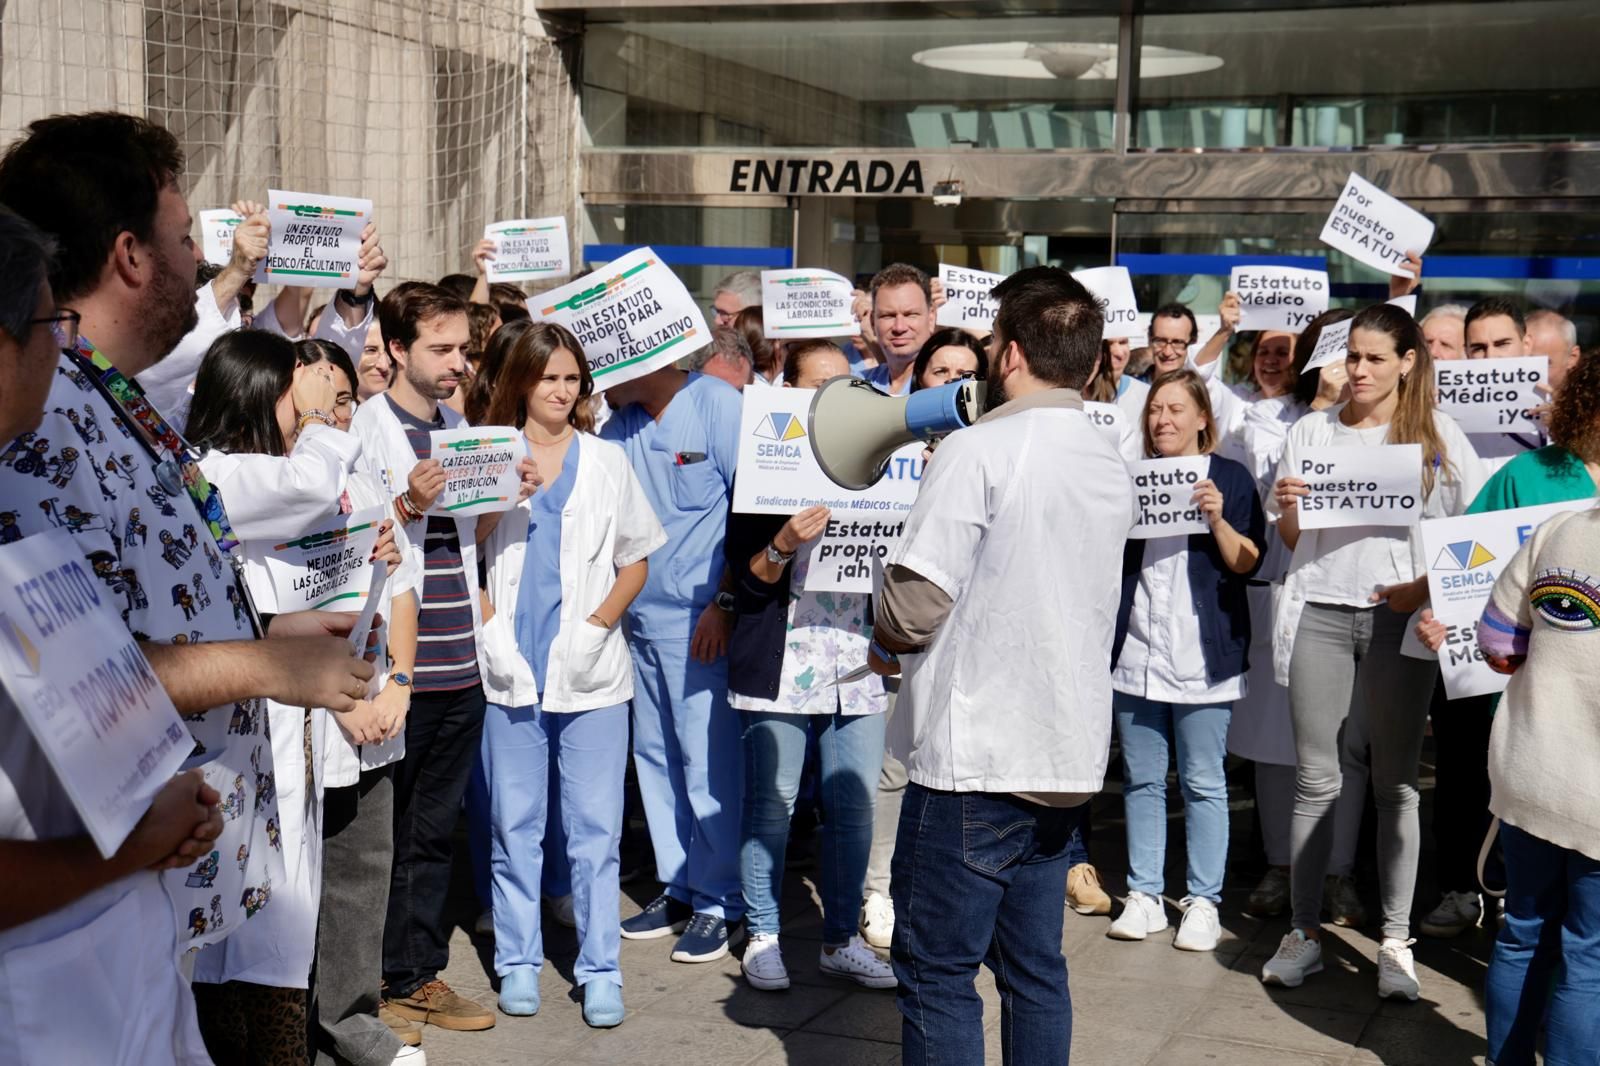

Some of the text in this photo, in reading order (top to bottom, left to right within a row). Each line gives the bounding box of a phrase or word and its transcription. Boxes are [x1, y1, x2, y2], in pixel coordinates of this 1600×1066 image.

[729, 160, 924, 193] ENTRADA
[1346, 185, 1373, 208] Por
[285, 224, 343, 237] UN ESTATUTO
[1338, 203, 1395, 242] nuestro
[283, 234, 340, 248] PROPIO PARA
[501, 238, 549, 248] UN ESTATUTO
[303, 247, 314, 258] EL
[530, 246, 550, 254] PARA
[1237, 274, 1323, 291] Estatuto
[787, 290, 831, 300] MEJORA DE
[1237, 291, 1304, 306] Médico
[572, 287, 653, 334] UN ESTATUTO
[776, 301, 790, 310] LAS
[787, 309, 833, 319] LABORALES
[579, 300, 663, 347] PROPIO PARA
[588, 315, 693, 372] DICO/FACULTATIVO
[618, 331, 635, 345] EL
[1438, 367, 1541, 386] Estatuto
[1437, 387, 1519, 404] Médico
[442, 449, 513, 467] CATEGORIZACIÓN
[756, 444, 802, 458] SEMCA
[478, 466, 483, 476] Y
[1301, 459, 1335, 475] Por
[1132, 468, 1198, 487] atuto
[755, 496, 798, 506] Sindicato
[850, 498, 891, 510] MÉDICOS
[1302, 495, 1415, 511] ESTATUTO
[824, 520, 904, 537] Estatut
[819, 539, 888, 562] propio
[306, 547, 355, 572] MEJORA DE
[293, 556, 363, 591] LAS CONDICONES
[1441, 570, 1496, 589] SEMCA
[305, 573, 349, 601] LABORALES
[14, 560, 101, 638] ESTATUTO
[69, 657, 137, 739] PROPIO
